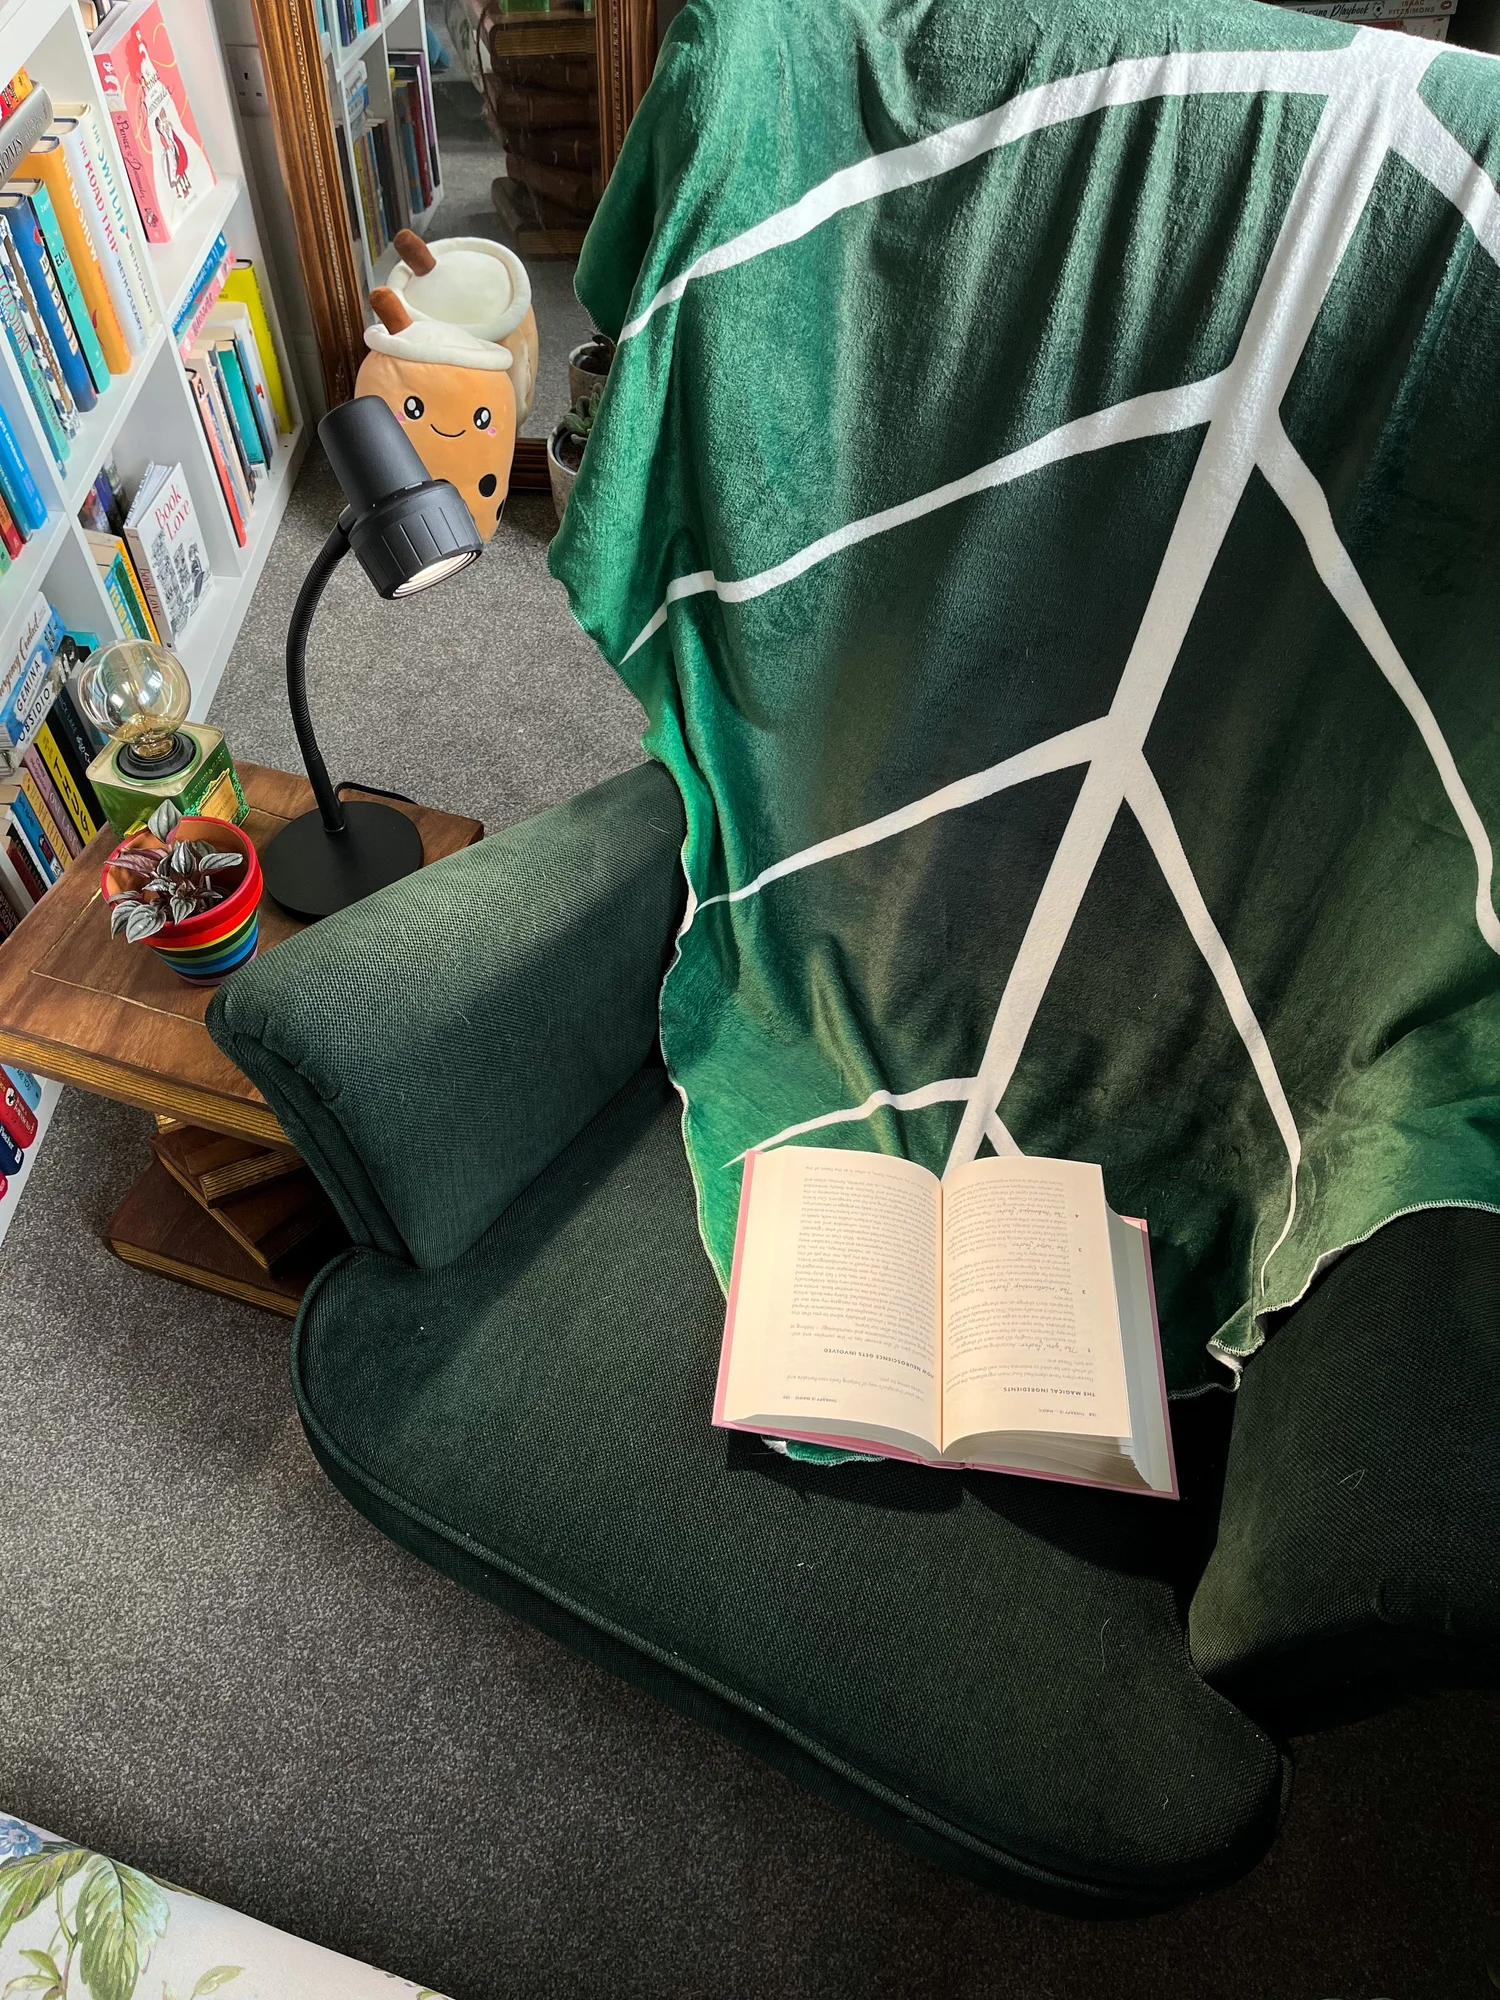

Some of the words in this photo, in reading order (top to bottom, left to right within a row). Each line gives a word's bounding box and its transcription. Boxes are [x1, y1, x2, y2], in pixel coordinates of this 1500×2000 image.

[1330, 2, 1370, 19] Playbook
[1388, 7, 1435, 17] FITZSIMONS
[98, 148, 123, 221] SWITCH
[84, 160, 105, 212] ROAD
[102, 214, 119, 253] TRIP
[129, 243, 140, 272] BETH
[117, 259, 128, 289] BETH
[126, 288, 143, 331] O'LEARY
[4, 432, 25, 472] EXPERIMENT
[154, 484, 182, 529] Book
[165, 500, 191, 541] Love
[109, 584, 121, 607] YES
[139, 568, 156, 591] Book
[148, 594, 161, 616] Love
[17, 612, 40, 660] Contact
[16, 660, 42, 710] GEMINA
[19, 687, 51, 741] OBSIDIO
[53, 756, 90, 836] THUG
[61, 817, 78, 847] LAST
[1057, 1245, 1069, 1253] The
[1060, 1287, 1073, 1295] The
[845, 1314, 866, 1322] probably
[824, 1348, 857, 1356] INVOLVED
[858, 1351, 874, 1359] GETS
[1064, 1346, 1078, 1354] The
[875, 1354, 921, 1371] NEUROSCIENCE
[842, 1378, 861, 1386] helping
[922, 1369, 934, 1379] HOW
[1062, 1374, 1094, 1382] Researchers
[879, 1384, 904, 1395] therapist's
[1050, 1388, 1081, 1396] MAGICAL
